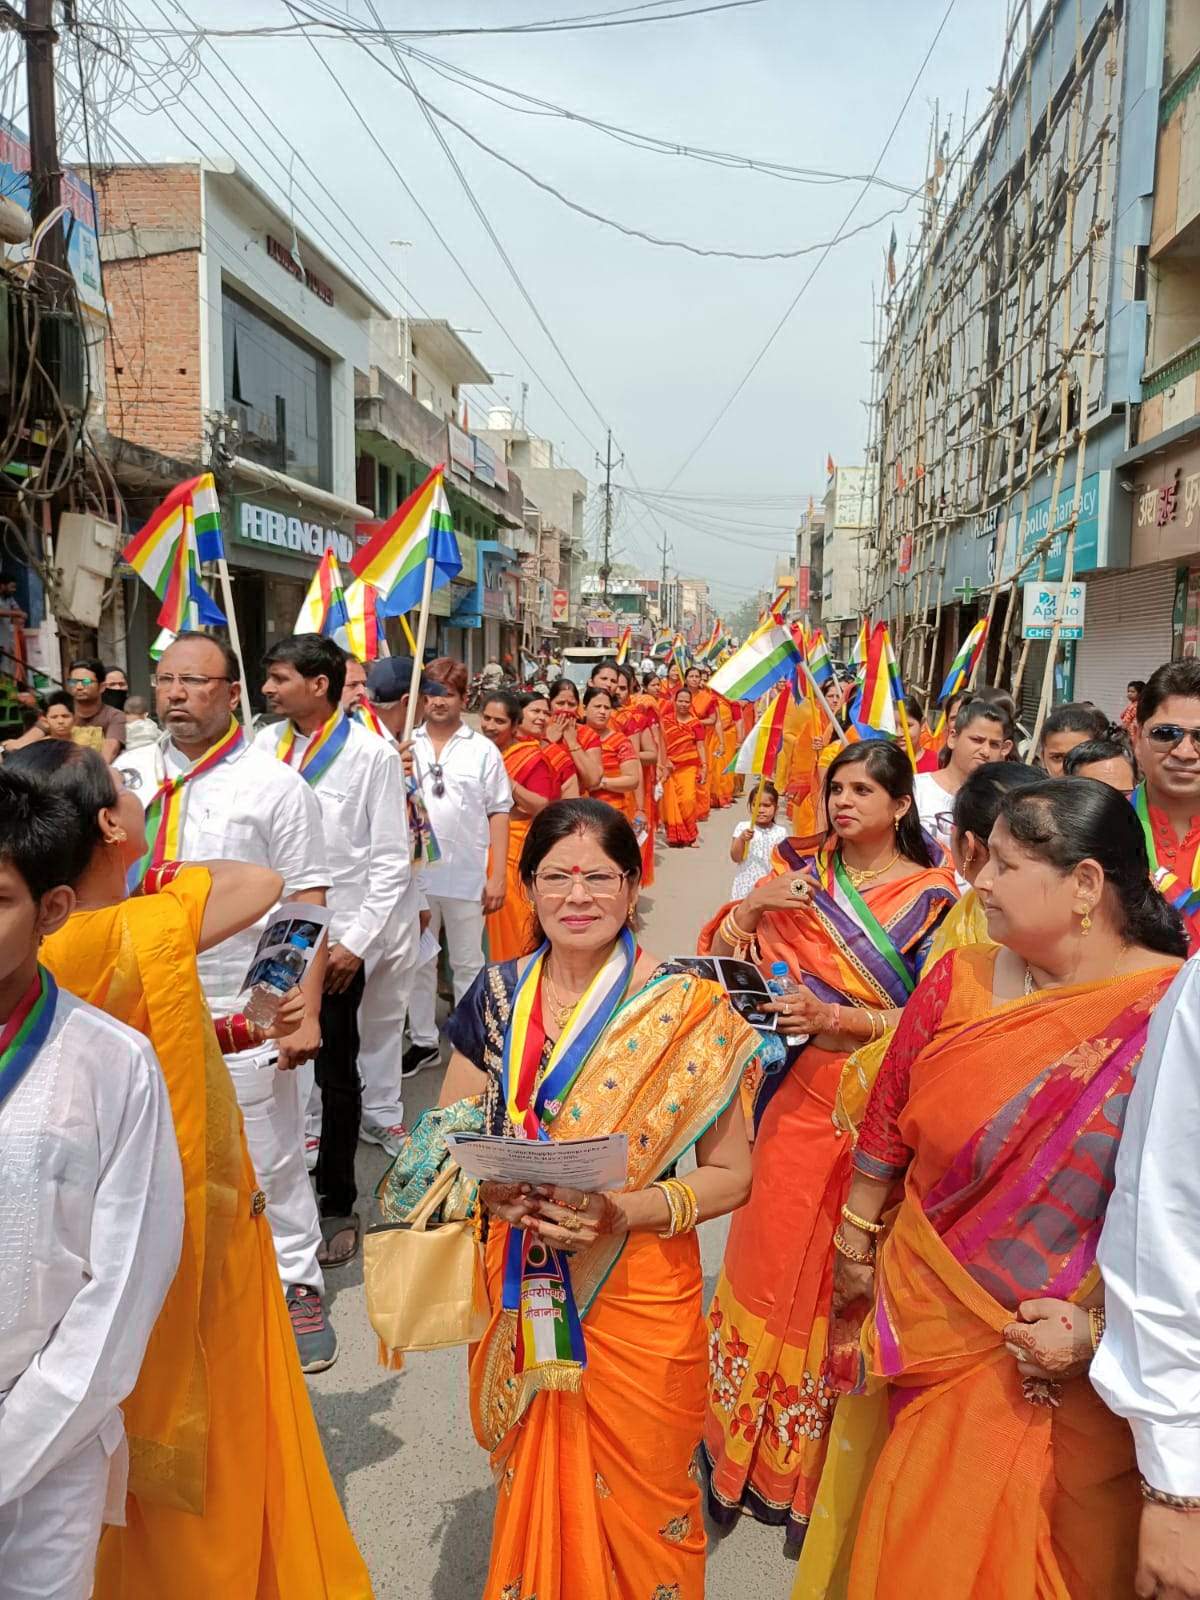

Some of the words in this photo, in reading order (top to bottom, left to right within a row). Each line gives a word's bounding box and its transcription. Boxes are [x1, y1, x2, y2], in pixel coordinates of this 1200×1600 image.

[241, 502, 287, 547] PETER
[287, 517, 353, 563] ENGLAND
[1027, 628, 1080, 638] CHEIST
